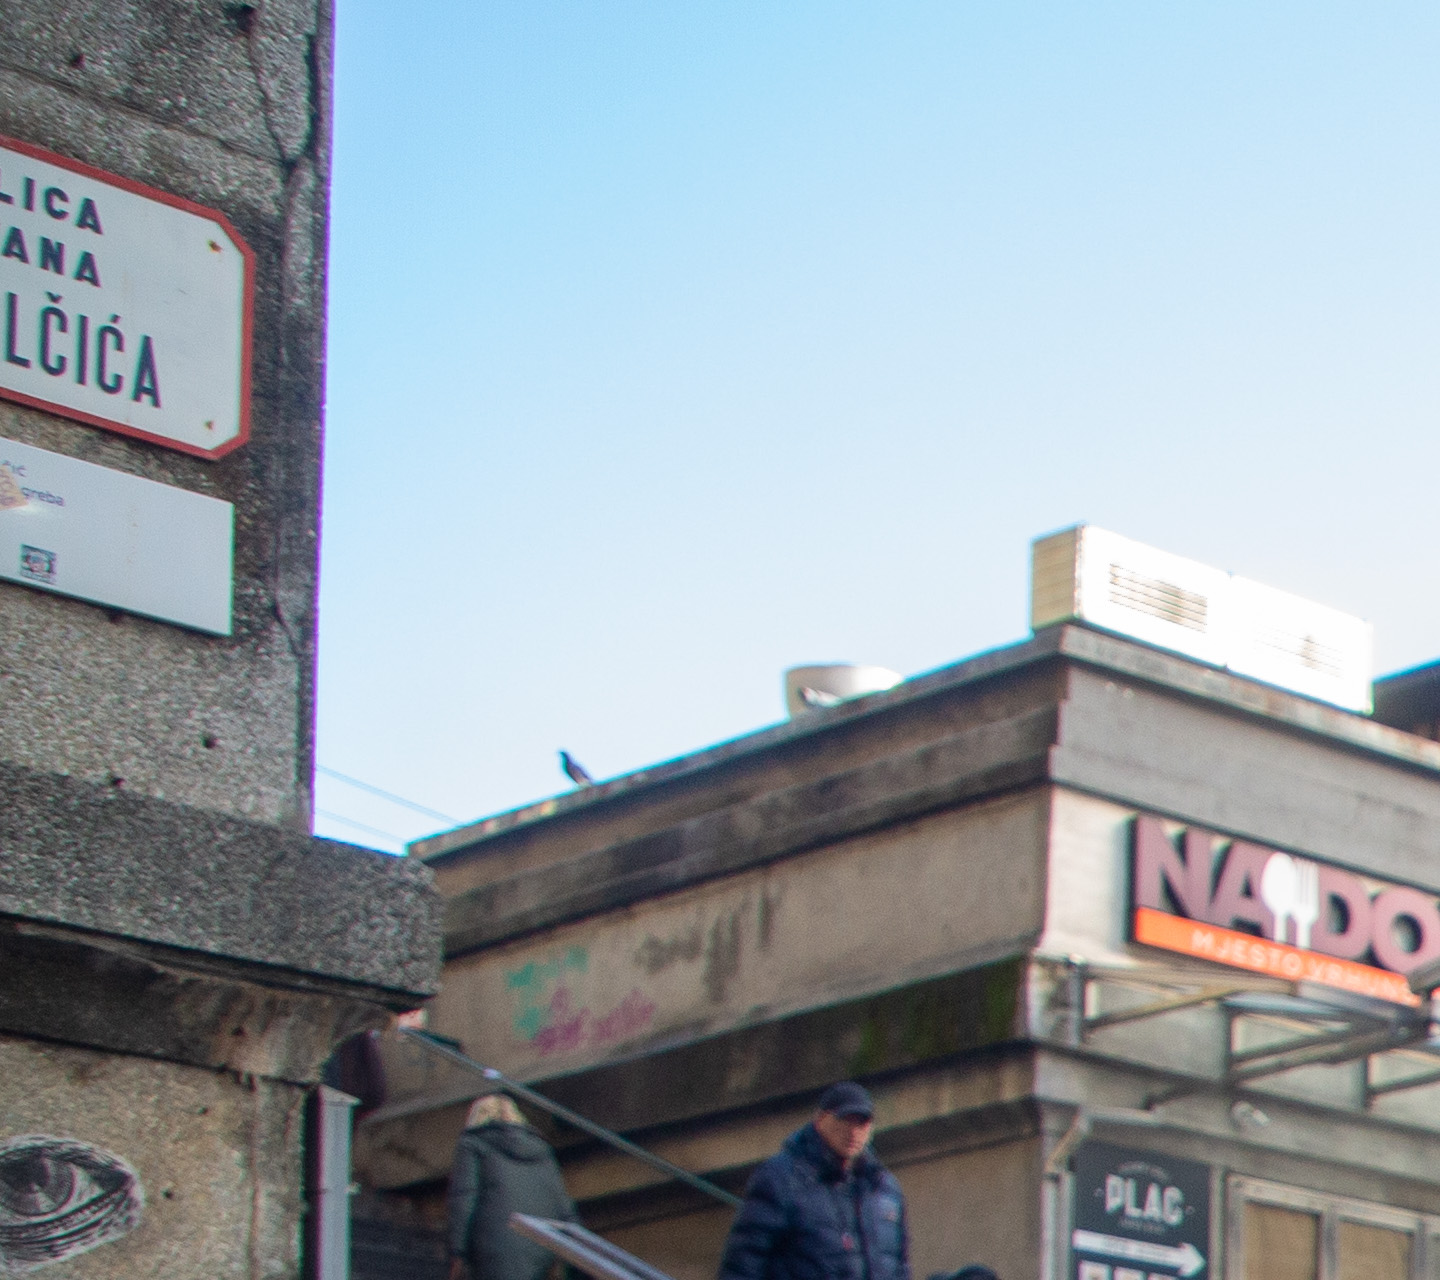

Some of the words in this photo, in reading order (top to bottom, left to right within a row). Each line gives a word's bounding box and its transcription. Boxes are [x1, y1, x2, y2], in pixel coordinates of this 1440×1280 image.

[0, 226, 101, 288] ANA
[1190, 928, 1302, 977] MJESTO
[1105, 1172, 1185, 1227] PLAC
